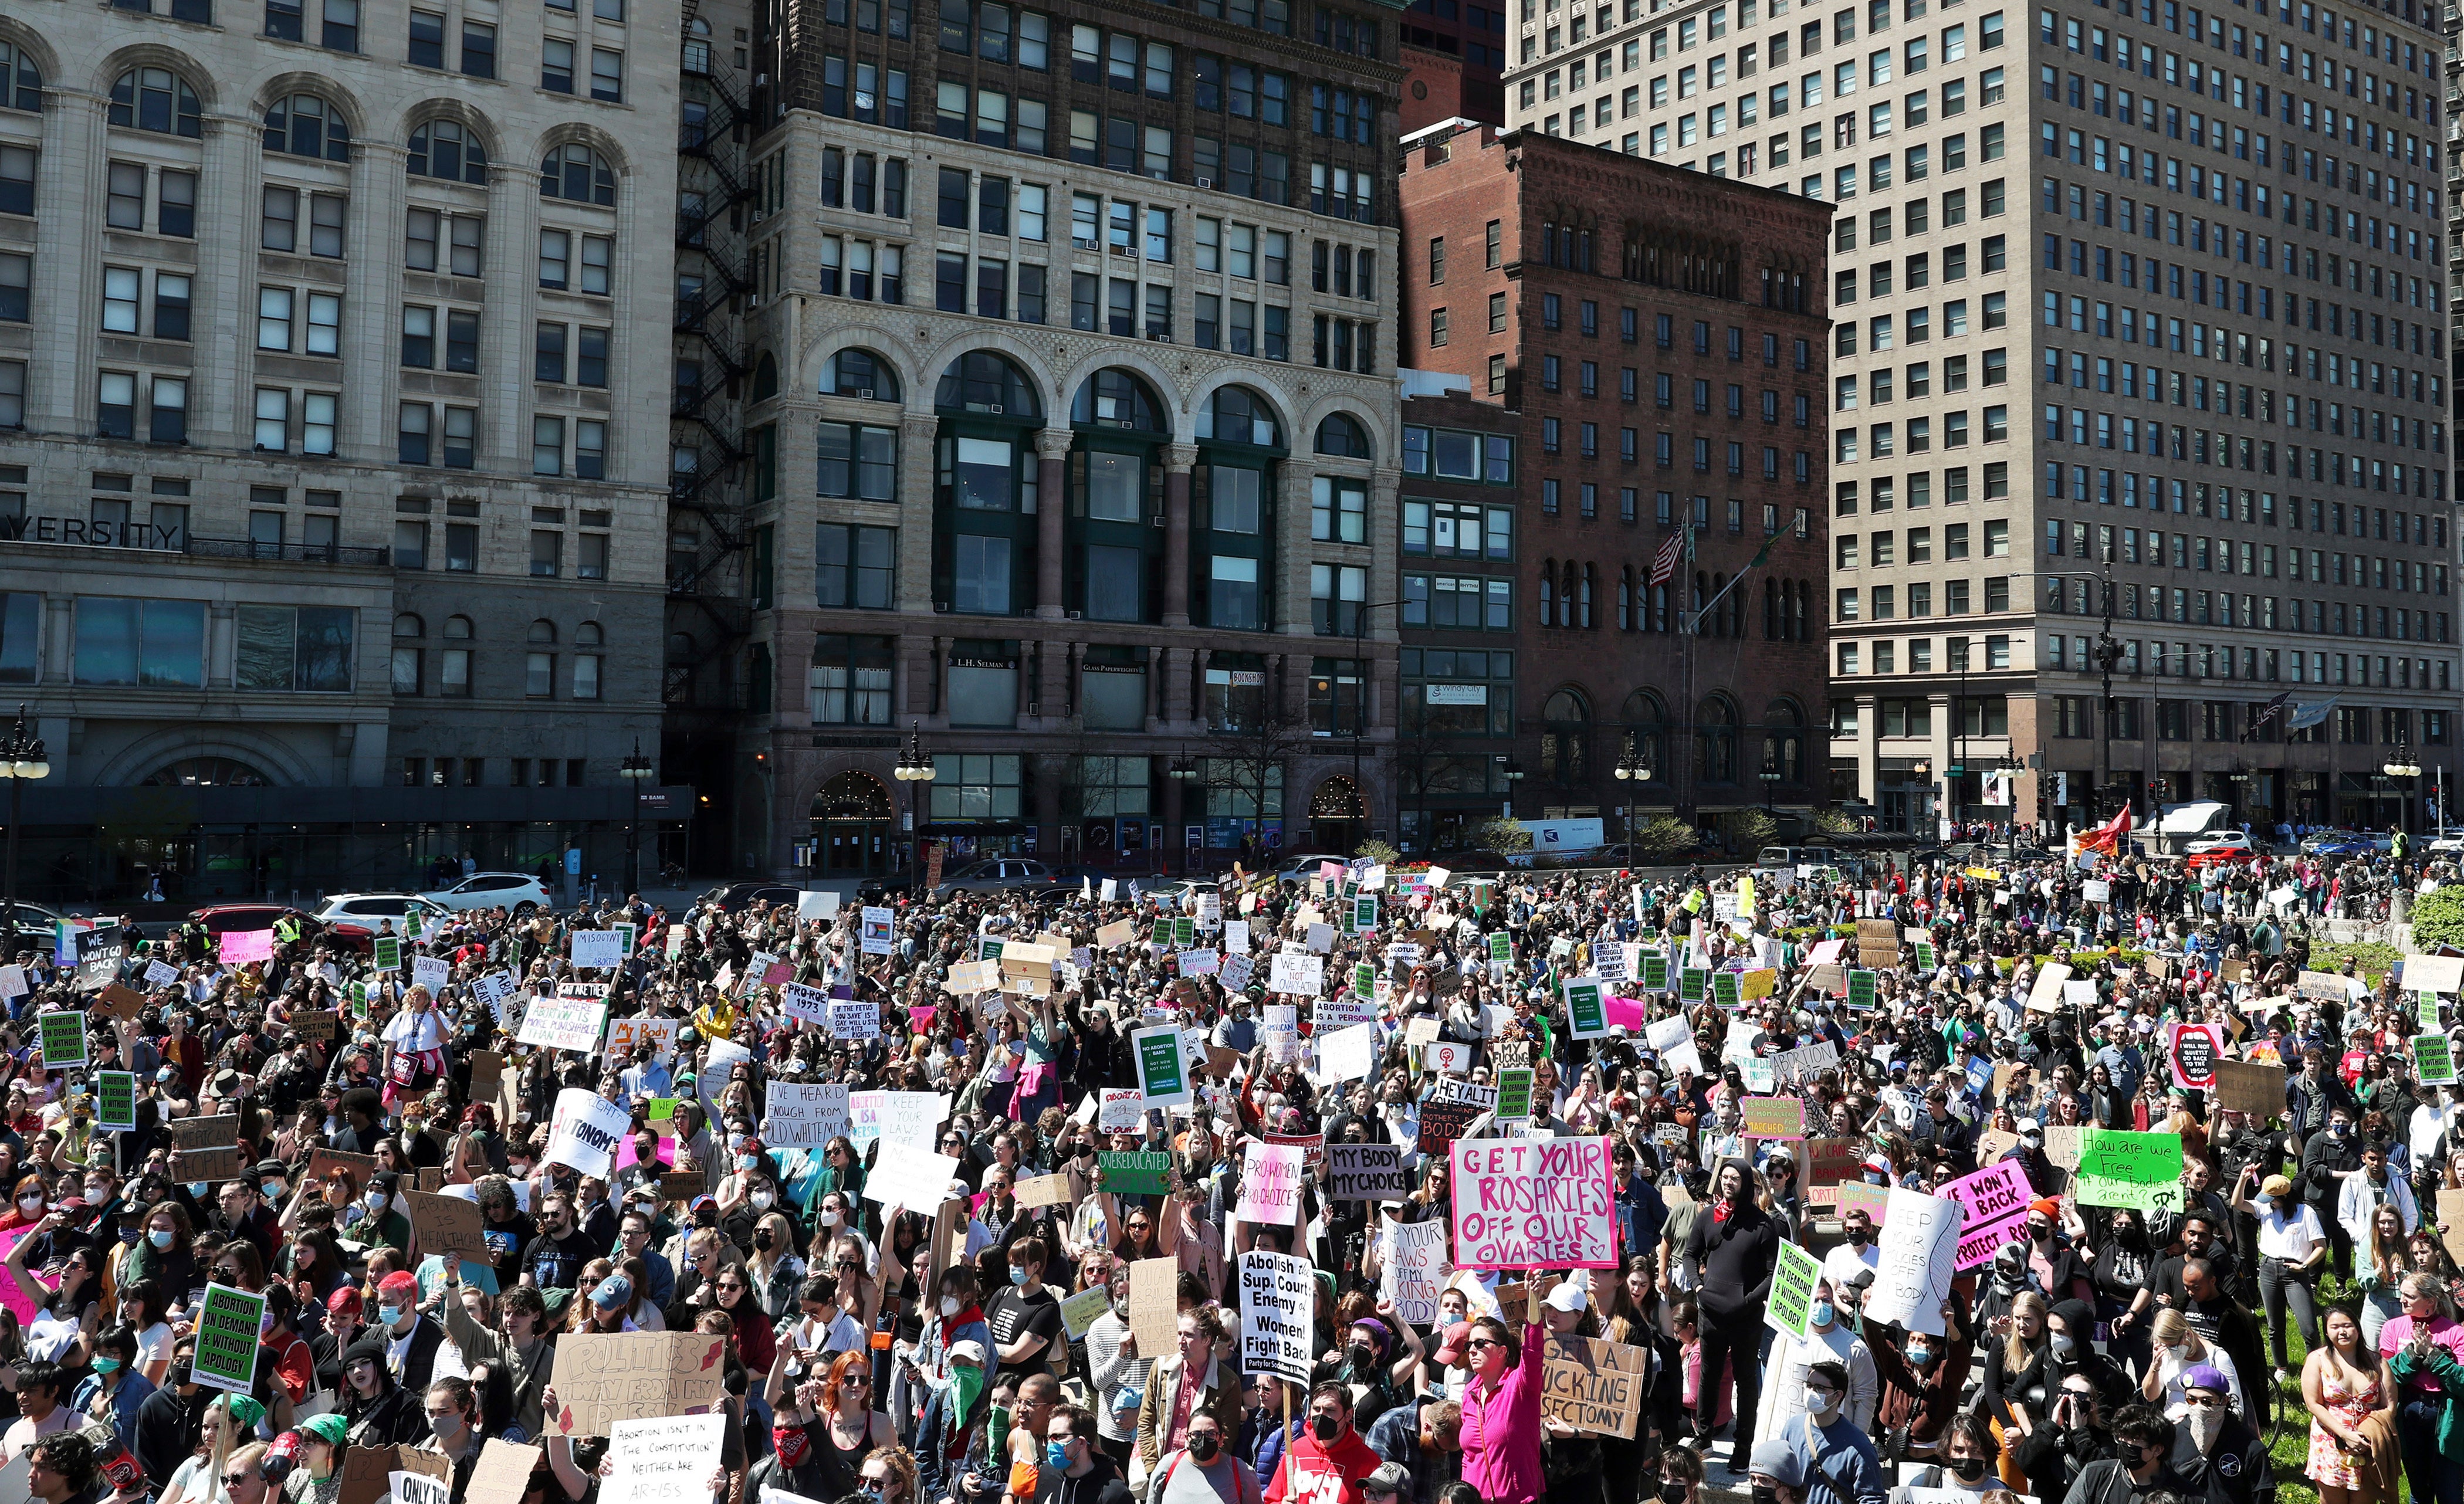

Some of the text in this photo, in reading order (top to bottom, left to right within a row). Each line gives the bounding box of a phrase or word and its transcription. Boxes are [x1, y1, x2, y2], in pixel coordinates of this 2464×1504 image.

[6, 514, 178, 549] VERSITY
[957, 659, 1004, 668] L.H. SELMAN
[1233, 672, 1264, 685] BOOKSHOP
[1443, 685, 1480, 693] Windy City
[1219, 873, 1232, 883] BREAK
[1232, 879, 1240, 888] THE
[87, 933, 103, 946] WE
[577, 933, 621, 943] MISOGYNY
[81, 946, 121, 964] WON'T GO
[1183, 956, 1211, 964] POLICIES
[90, 958, 116, 972] BACK
[417, 960, 448, 973] ABORTION
[1281, 957, 1316, 972] WE ARE
[1289, 972, 1305, 981] NOT
[2306, 974, 2330, 983] WOMEN
[787, 982, 827, 1004] PRO-ROE
[1279, 978, 1319, 993] OVARY-ACTING
[2304, 988, 2344, 1000] RELIGIOUS PAWNS
[796, 998, 819, 1014] 1973
[1317, 1004, 1360, 1012] ABORTION
[45, 1017, 77, 1027] ABORTION
[54, 1027, 81, 1036] DEMAND
[52, 1039, 80, 1048] WITHOUT
[1150, 1043, 1174, 1051] ABORTION
[49, 1047, 79, 1057] APOLOGY
[769, 1085, 844, 1102] I'VE HEARD
[893, 1096, 923, 1109] KEEP
[1745, 1099, 1800, 1109] SERIOUSLY?
[769, 1105, 842, 1117] ENOUGH FROM
[897, 1111, 922, 1122] YOUR
[889, 1123, 920, 1134] LAWS
[1657, 1123, 1684, 1133] BLACK
[1746, 1122, 1783, 1133] MARCHED
[177, 1127, 234, 1148] AMERICAN
[1657, 1136, 1686, 1144] MATTER
[2083, 1135, 2172, 1157] How are we
[176, 1151, 236, 1179] PEOPLE
[1098, 1151, 1170, 1171] OVEREDUCATED
[1332, 1147, 1401, 1170] MY BODY
[1464, 1141, 1602, 1180] GET YOUR
[1332, 1173, 1405, 1194] MY CHOICE
[2099, 1175, 2121, 1187] our
[2130, 1174, 2173, 1188] bodies
[1478, 1176, 1609, 1217] ROSARIES
[1979, 1188, 2020, 1215] BACK
[2097, 1188, 2146, 1204] aren't?
[1462, 1212, 1598, 1243] OFF OUR
[1477, 1238, 1583, 1264] OVARIES
[1956, 1232, 1998, 1262] PROTECT
[1389, 1248, 1427, 1268] LAWS
[1784, 1248, 1814, 1278] ABORTION
[1246, 1255, 1310, 1278] Abolish the
[1396, 1268, 1423, 1281] OFF MY
[1778, 1264, 1812, 1298] ON DEMAND
[1243, 1272, 1311, 1297] Sup. Court:
[212, 1295, 256, 1317] ABORTION
[1253, 1292, 1306, 1317] Enemy of
[1775, 1284, 1808, 1313] & WITHOUT
[1395, 1298, 1437, 1321] BODY
[1773, 1302, 1802, 1327] APOLOGY
[204, 1313, 258, 1337] ON DEMAND
[1256, 1316, 1305, 1340] Women!
[203, 1333, 252, 1357] & WITHOUT
[1246, 1336, 1309, 1365] Fight Back!
[204, 1351, 245, 1375] APOLOGY
[566, 1336, 702, 1379] POLITICS
[556, 1379, 715, 1402] AWAY FROM MY
[666, 1425, 689, 1437] ISN'T
[621, 1446, 642, 1455] THE
[114, 1466, 129, 1480] Cola
[632, 1461, 693, 1475] NEITHER ARE
